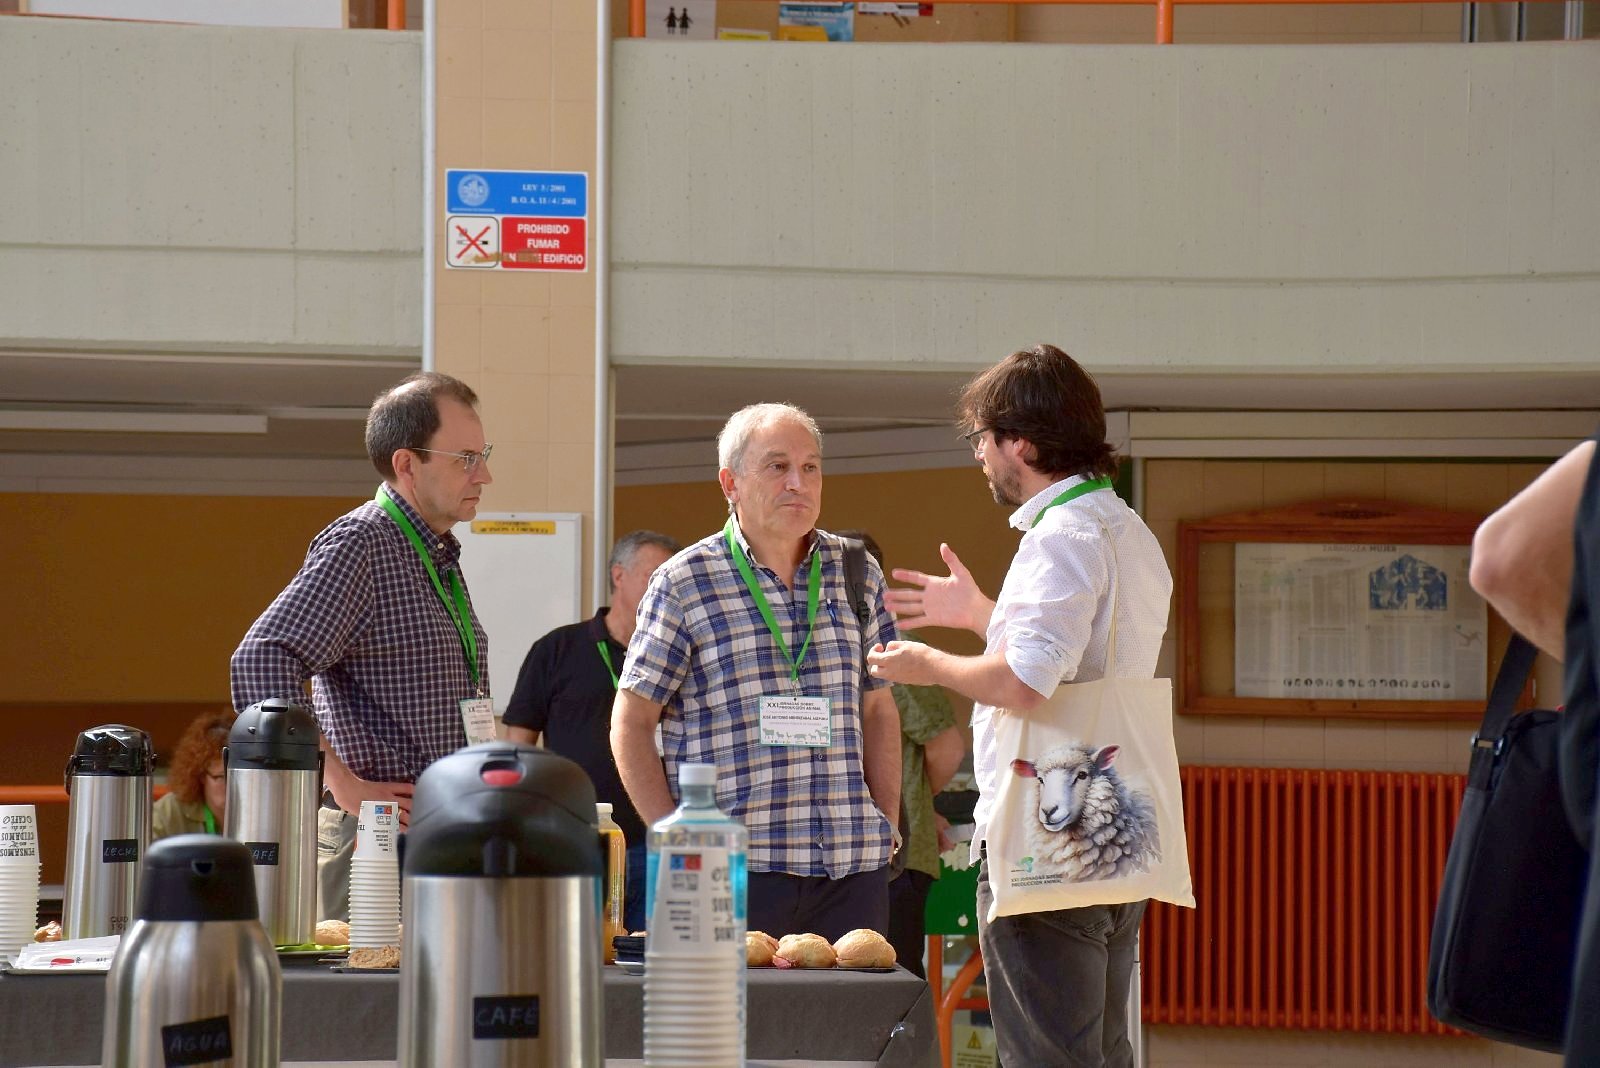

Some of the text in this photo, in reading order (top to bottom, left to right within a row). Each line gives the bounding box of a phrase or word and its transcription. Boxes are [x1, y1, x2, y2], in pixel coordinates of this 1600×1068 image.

[521, 183, 537, 191] LEY
[517, 223, 570, 235] PROHIBIDO
[526, 238, 560, 249] FUMAR
[543, 253, 584, 265] EDIFICIO
[1, 832, 35, 841] CUIDAMOS
[0, 848, 35, 857] PENSAMOS
[103, 846, 137, 857] LECHE
[251, 846, 276, 861] AFÉ
[169, 1031, 229, 1055] AGUA
